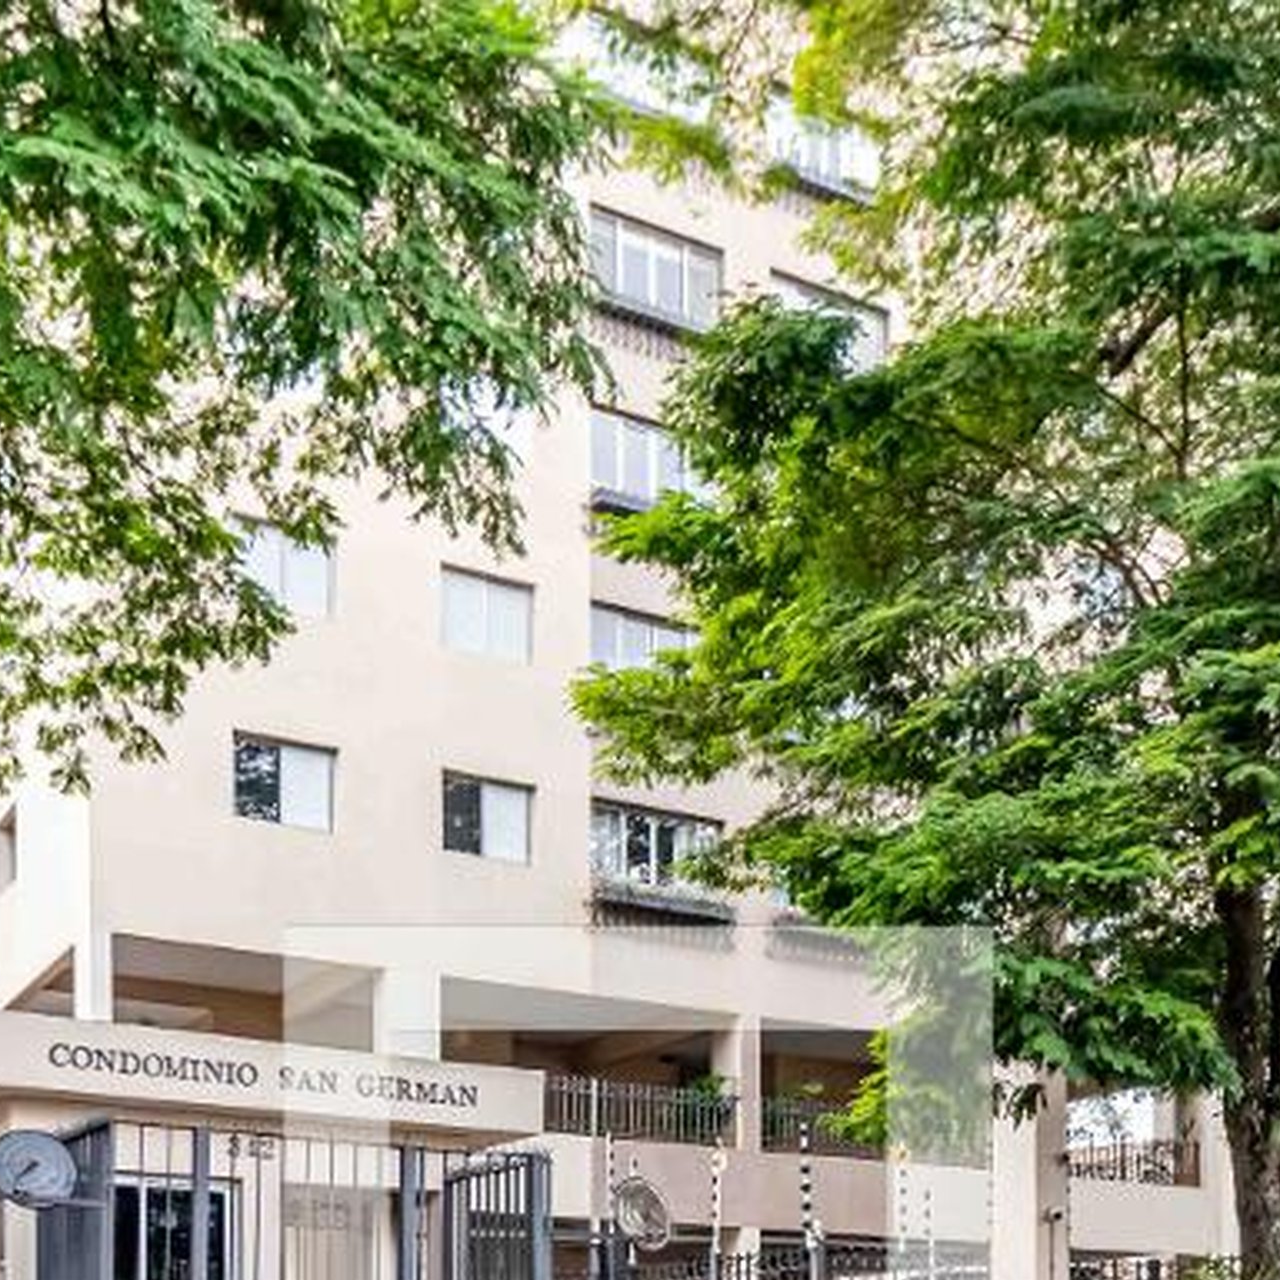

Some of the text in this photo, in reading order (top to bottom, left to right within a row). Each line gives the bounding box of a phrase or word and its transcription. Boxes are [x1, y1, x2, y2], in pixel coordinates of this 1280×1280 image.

[48, 1042, 479, 1108] CONDOMINIO SAN GERMAN
